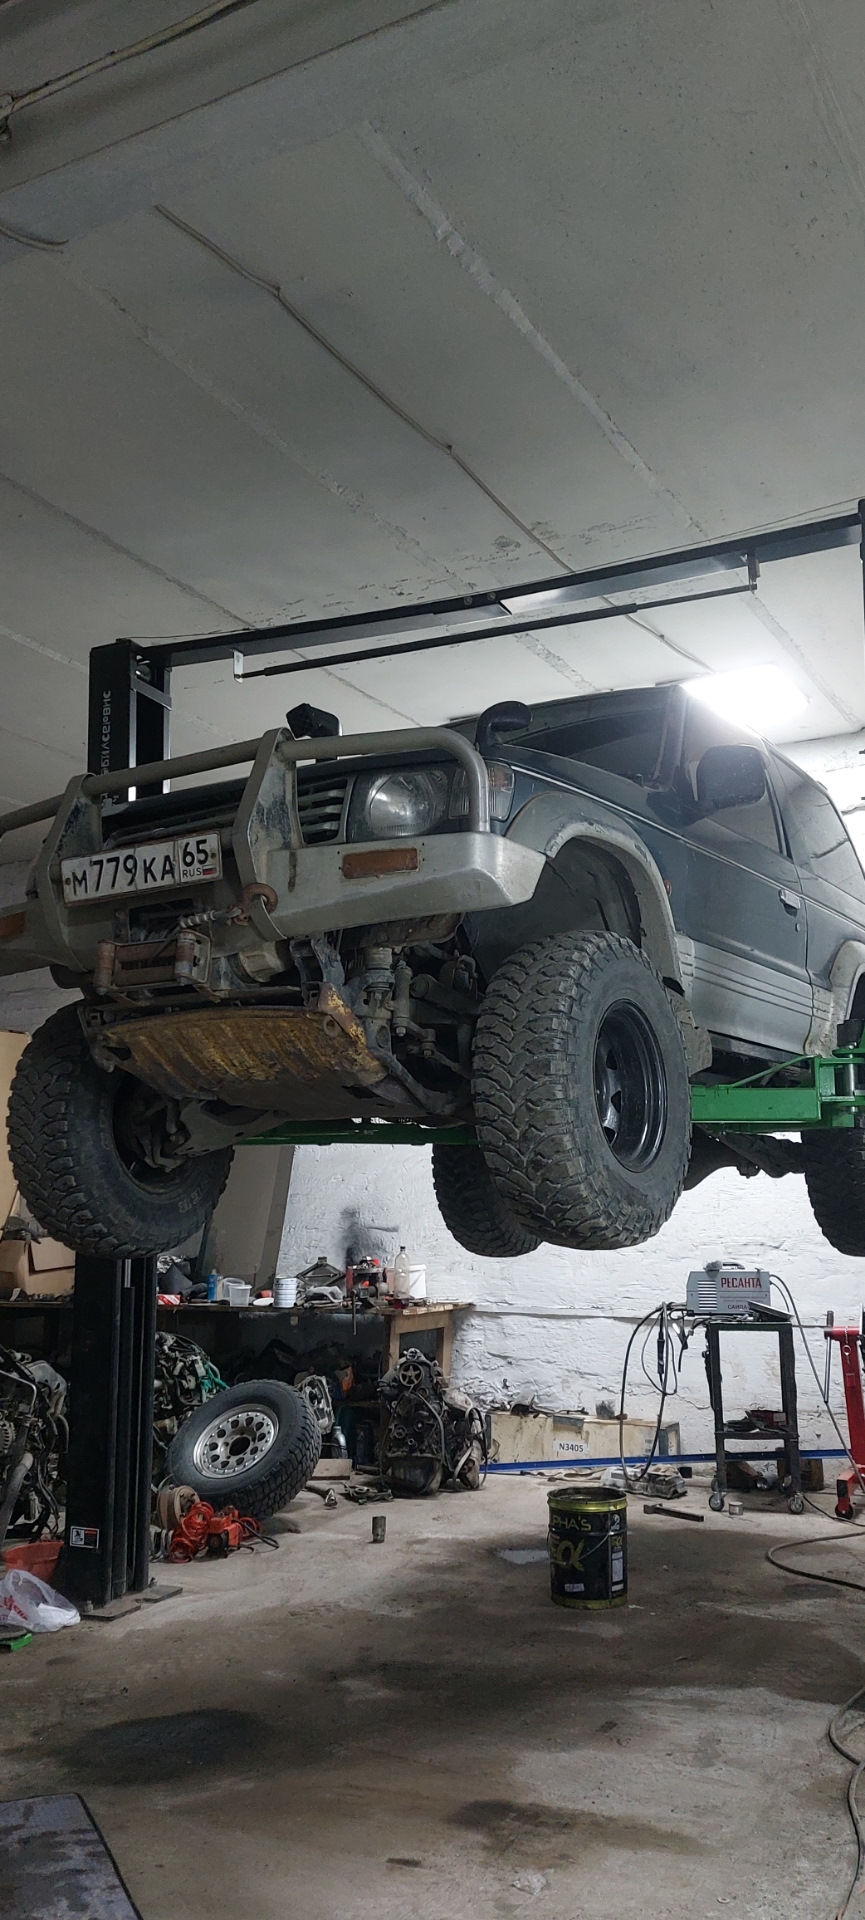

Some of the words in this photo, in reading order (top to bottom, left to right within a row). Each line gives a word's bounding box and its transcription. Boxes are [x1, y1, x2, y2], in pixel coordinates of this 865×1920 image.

[182, 839, 209, 868] 65
[182, 866, 202, 878] RUS
[721, 1277, 762, 1289] РЕСАНТА
[559, 1443, 584, 1453] N3405
[552, 1514, 592, 1532] PHA'S
